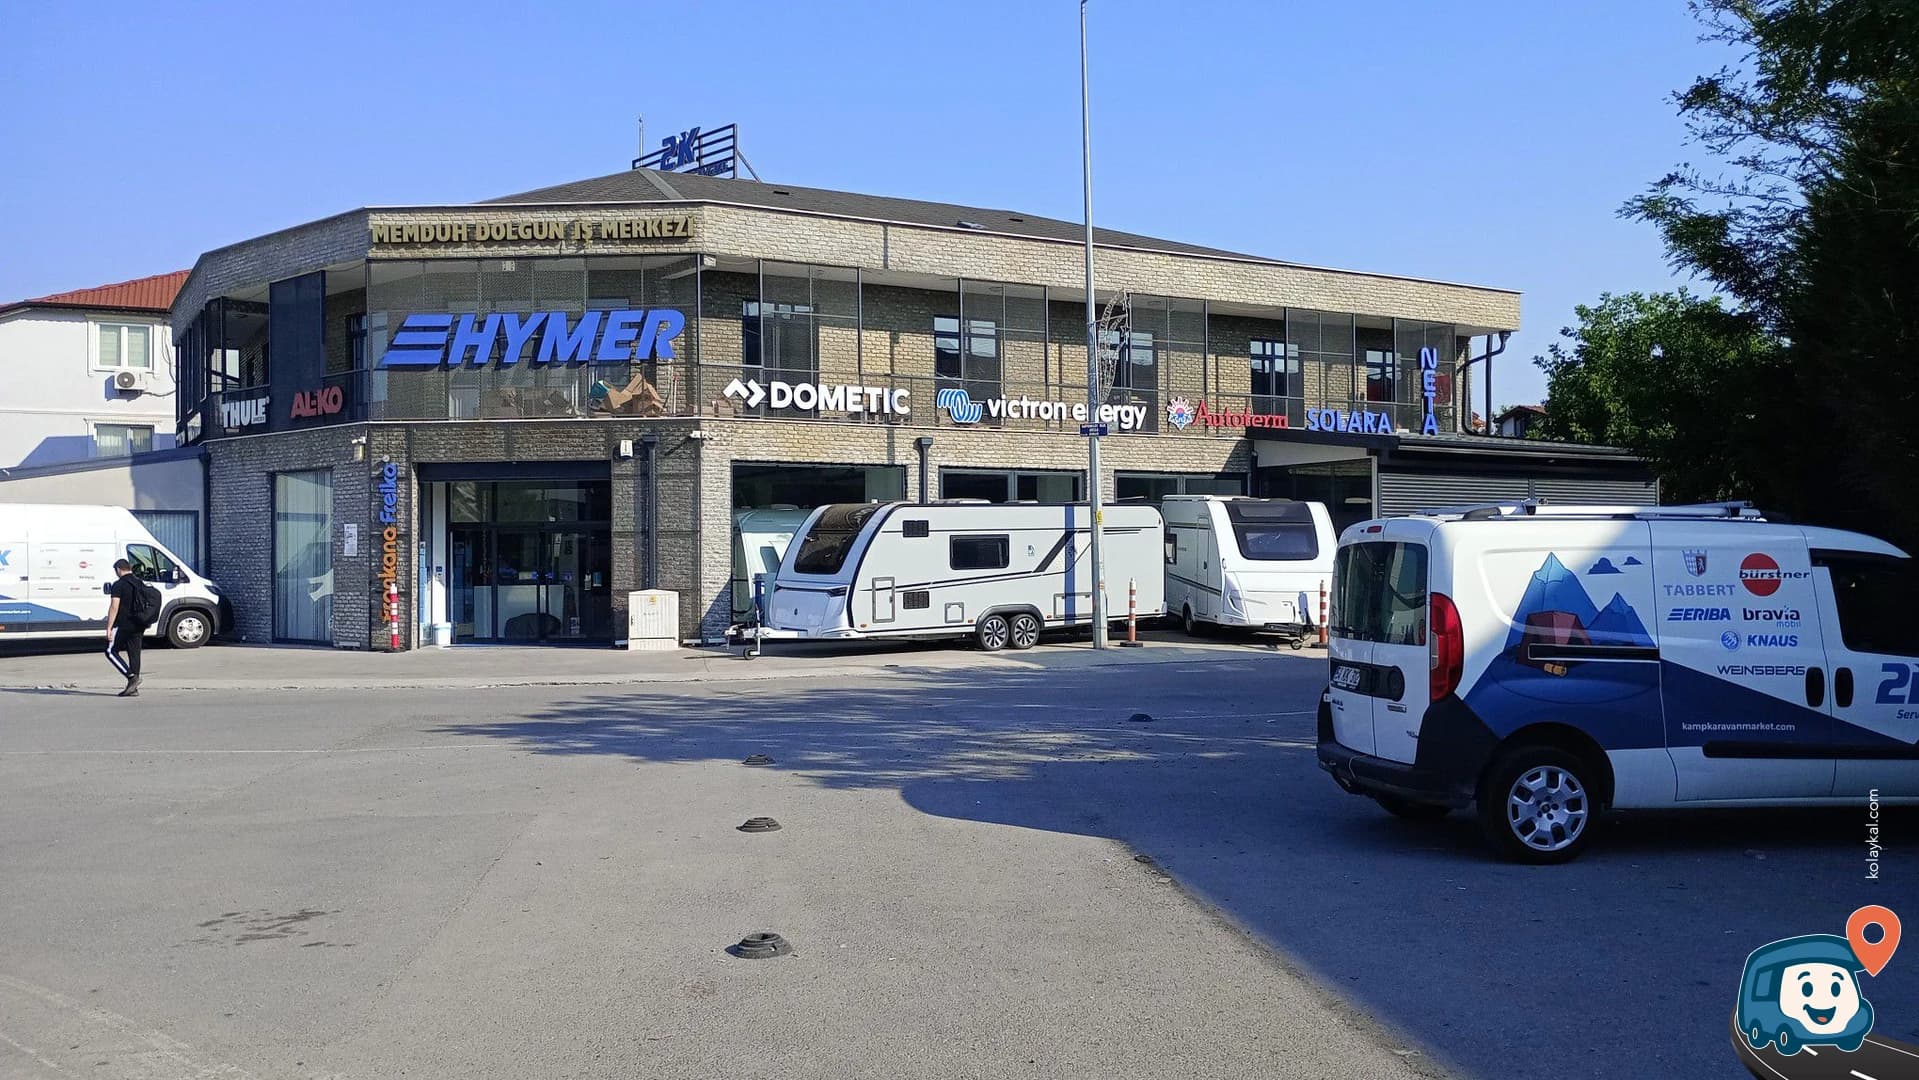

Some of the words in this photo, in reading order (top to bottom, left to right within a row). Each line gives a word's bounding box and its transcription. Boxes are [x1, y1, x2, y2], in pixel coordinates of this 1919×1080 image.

[660, 126, 701, 170] 2K
[371, 222, 468, 244] MEMDUH
[475, 219, 565, 241] DOLGUN
[601, 214, 695, 239] MERKEZİ
[447, 309, 686, 365] HYMER
[290, 386, 344, 419] AL-KO
[770, 381, 911, 415] DOMETIC
[987, 394, 1067, 421] victron
[221, 398, 267, 428] THULE
[1191, 400, 1289, 429] Autoterm
[1306, 407, 1393, 434] SOLARA
[1739, 569, 1810, 579] bürstner
[1664, 584, 1735, 596] TABBERT
[1682, 608, 1731, 621] ERIBA
[1743, 605, 1800, 620] bravia
[1747, 634, 1798, 647] KNAUS
[1682, 721, 1797, 733] kampkaravanmarket.com
